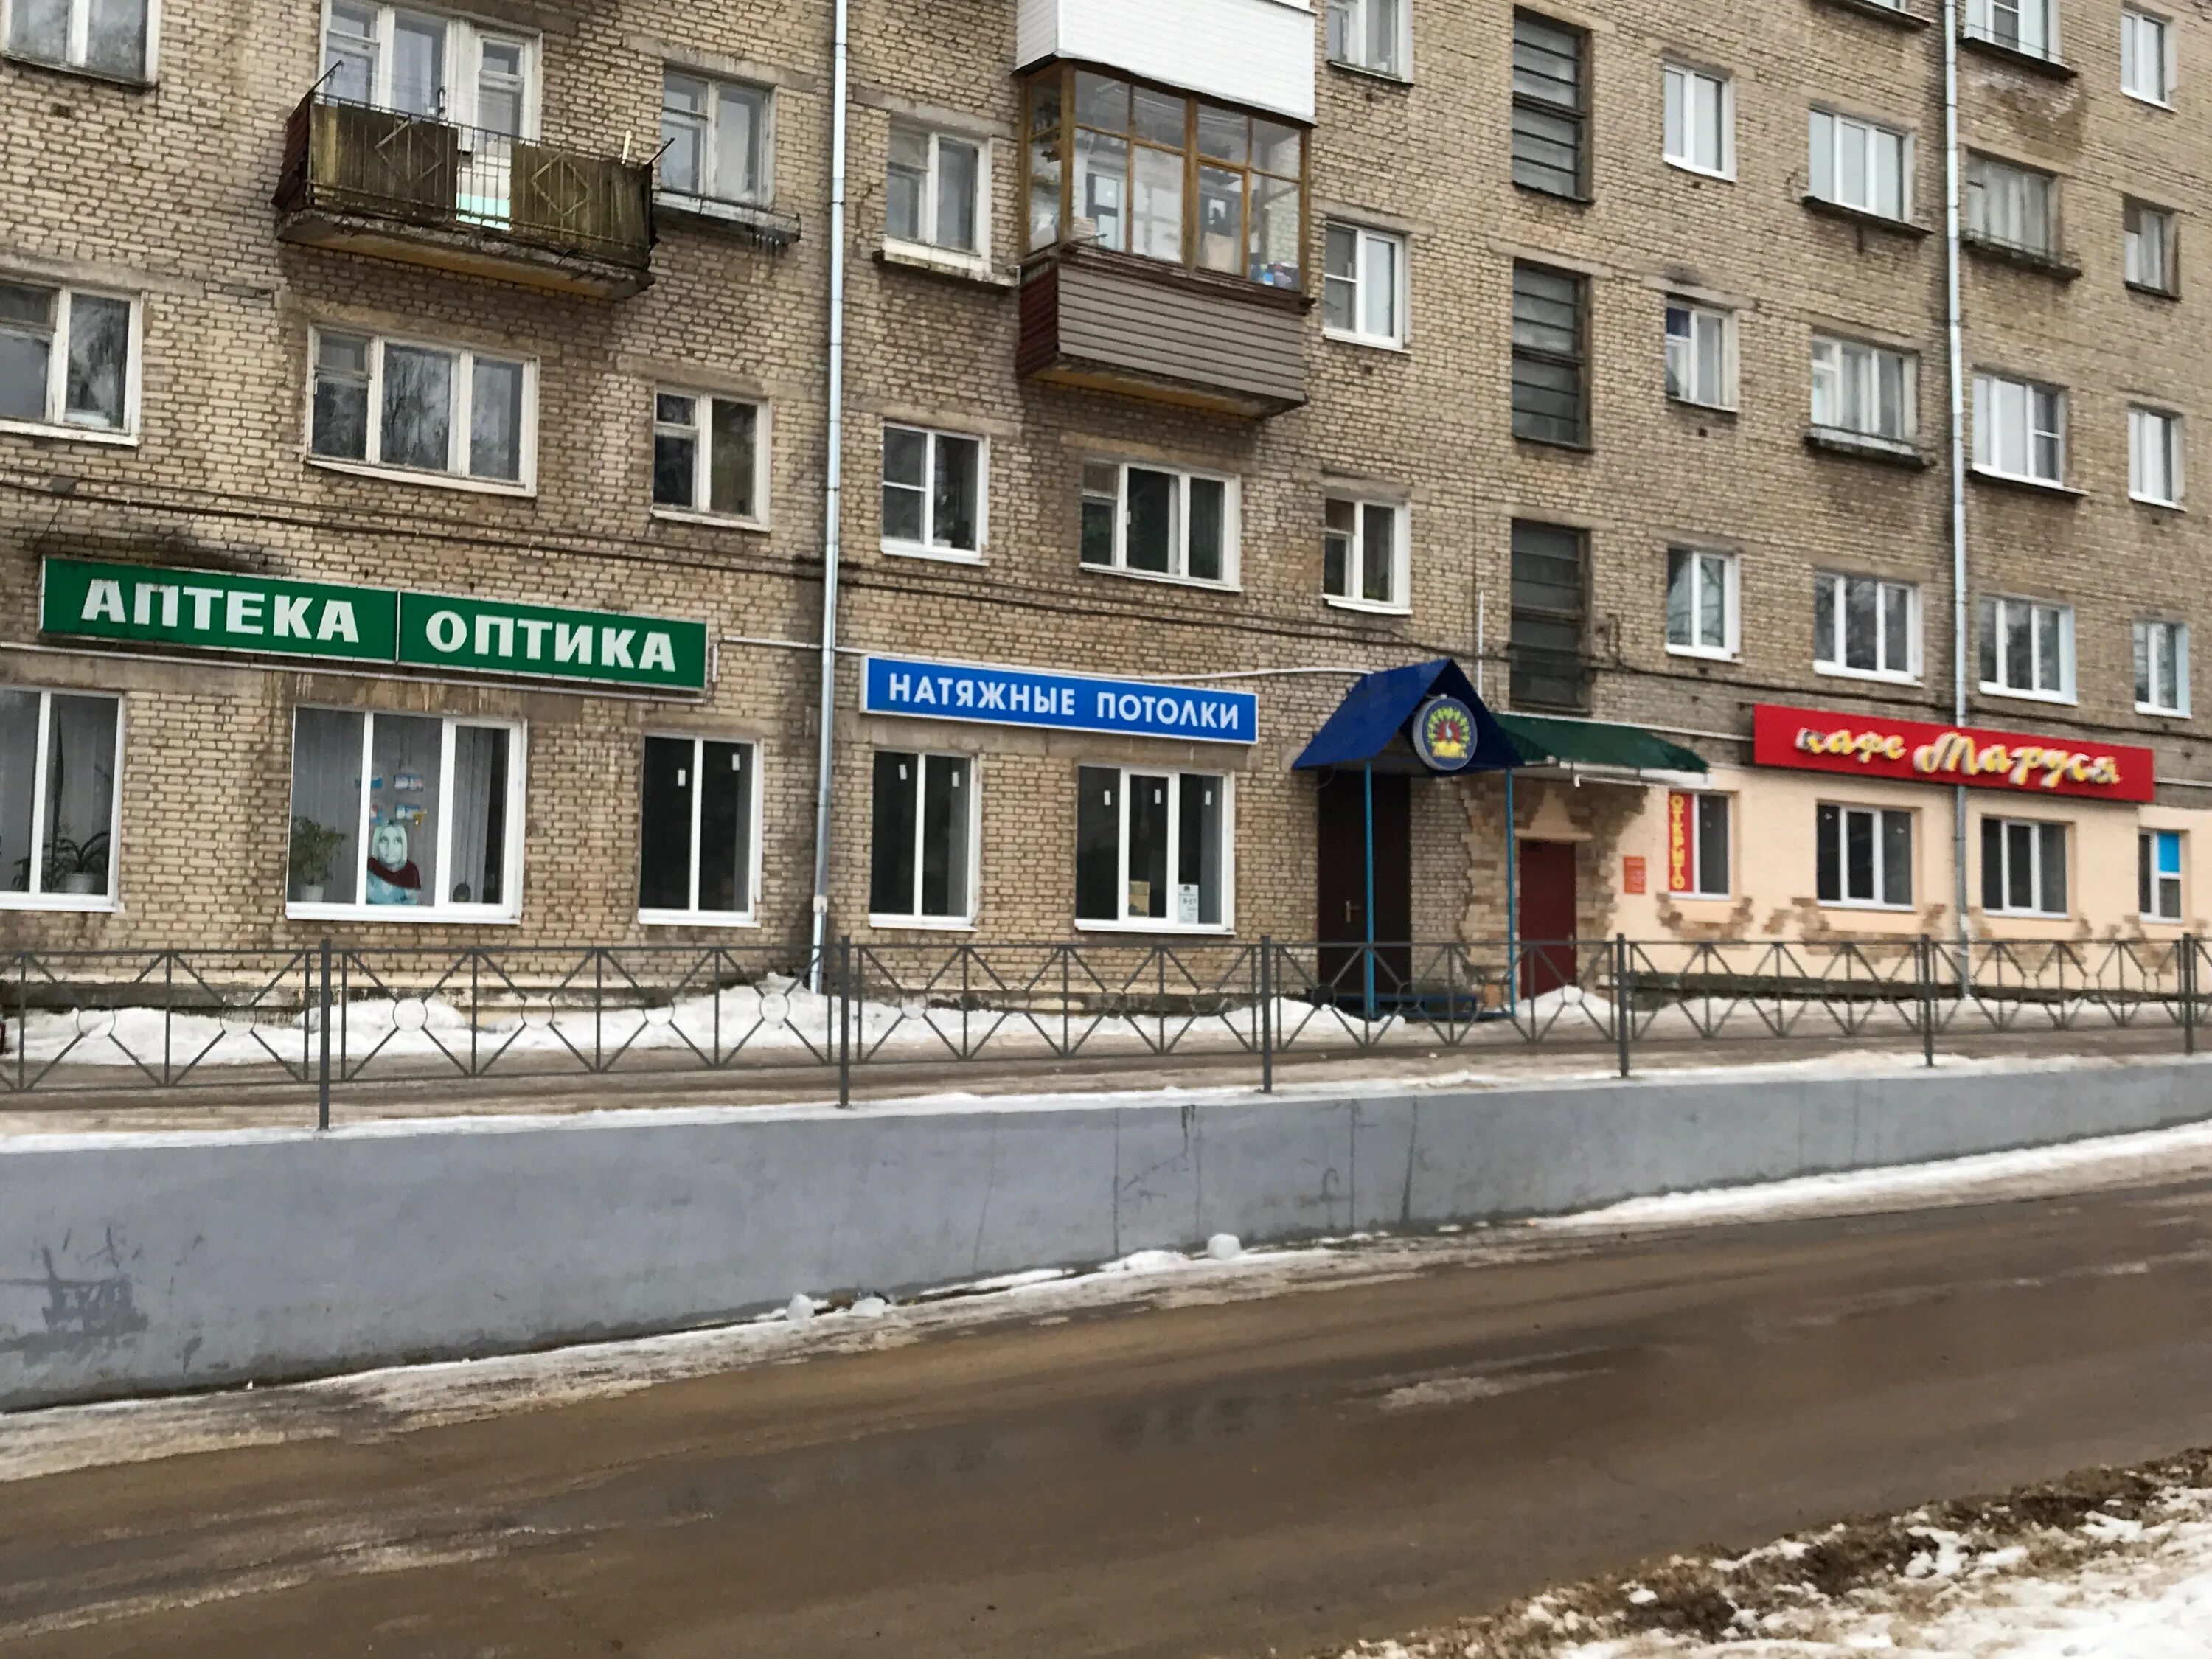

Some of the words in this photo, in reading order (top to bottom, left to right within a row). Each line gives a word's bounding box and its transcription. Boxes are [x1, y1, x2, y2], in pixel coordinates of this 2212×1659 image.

[81, 579, 359, 643] АПТЕКА
[425, 611, 675, 672] ОПТИКА
[889, 673, 1074, 715] НАТЯЖНЫЕ
[1097, 692, 1238, 730] ПОТОЛКИ
[1913, 731, 2121, 788] Маруся
